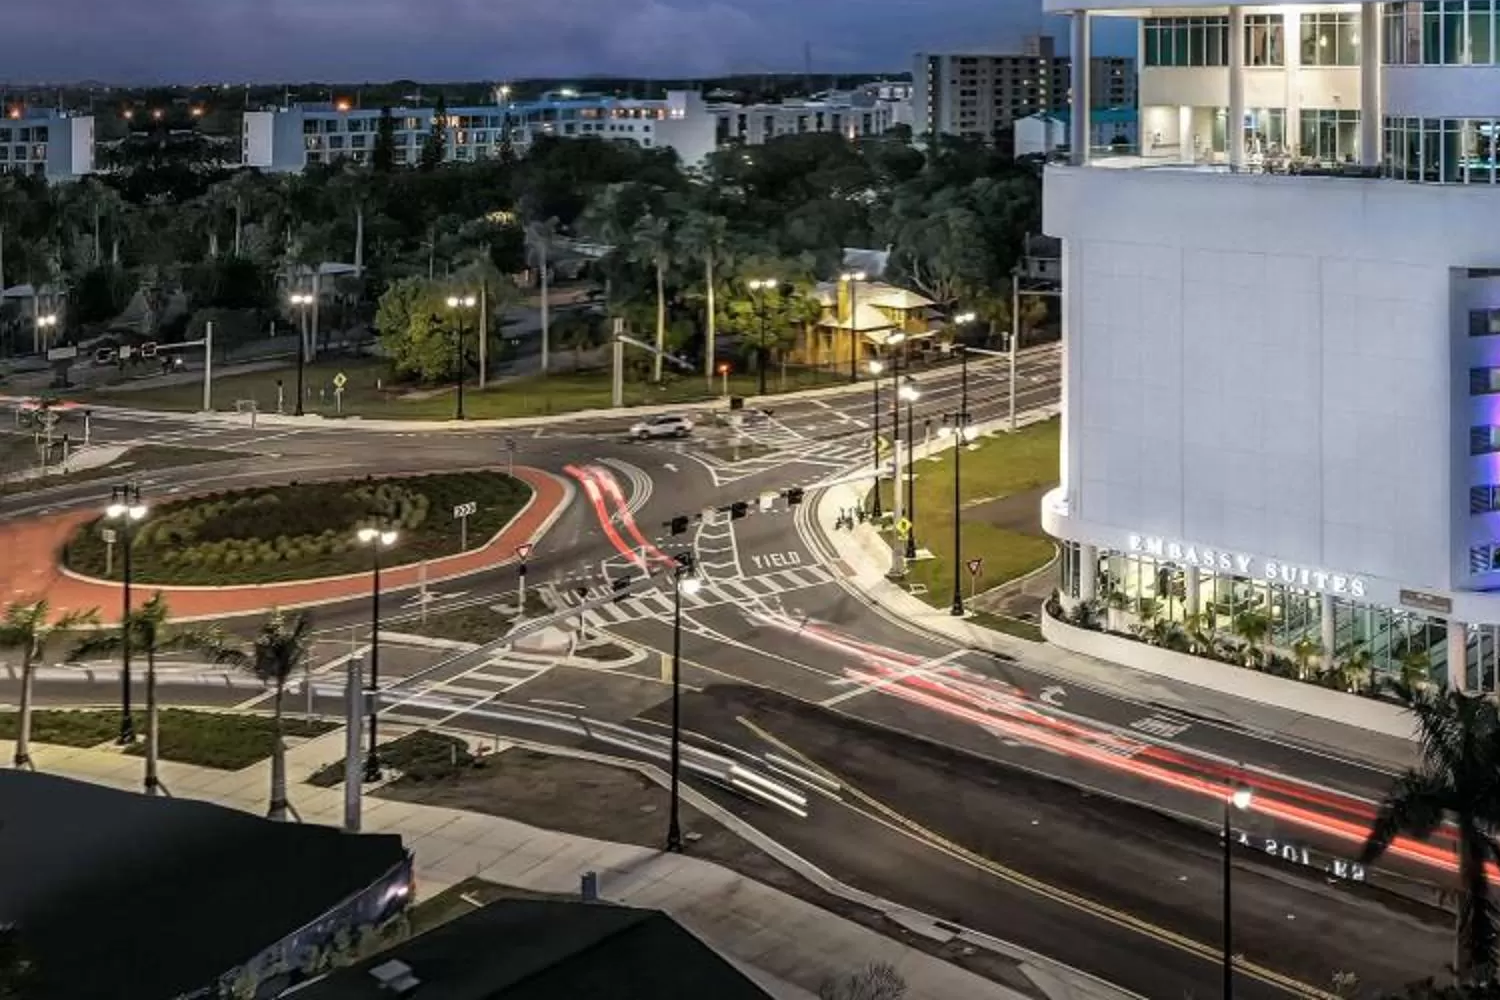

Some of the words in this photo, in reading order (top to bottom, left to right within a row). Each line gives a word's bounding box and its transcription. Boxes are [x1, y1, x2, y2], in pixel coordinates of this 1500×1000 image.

[751, 551, 801, 569] YIELD
[1129, 534, 1250, 572] EMBASSY
[1265, 560, 1366, 598] SUITES
